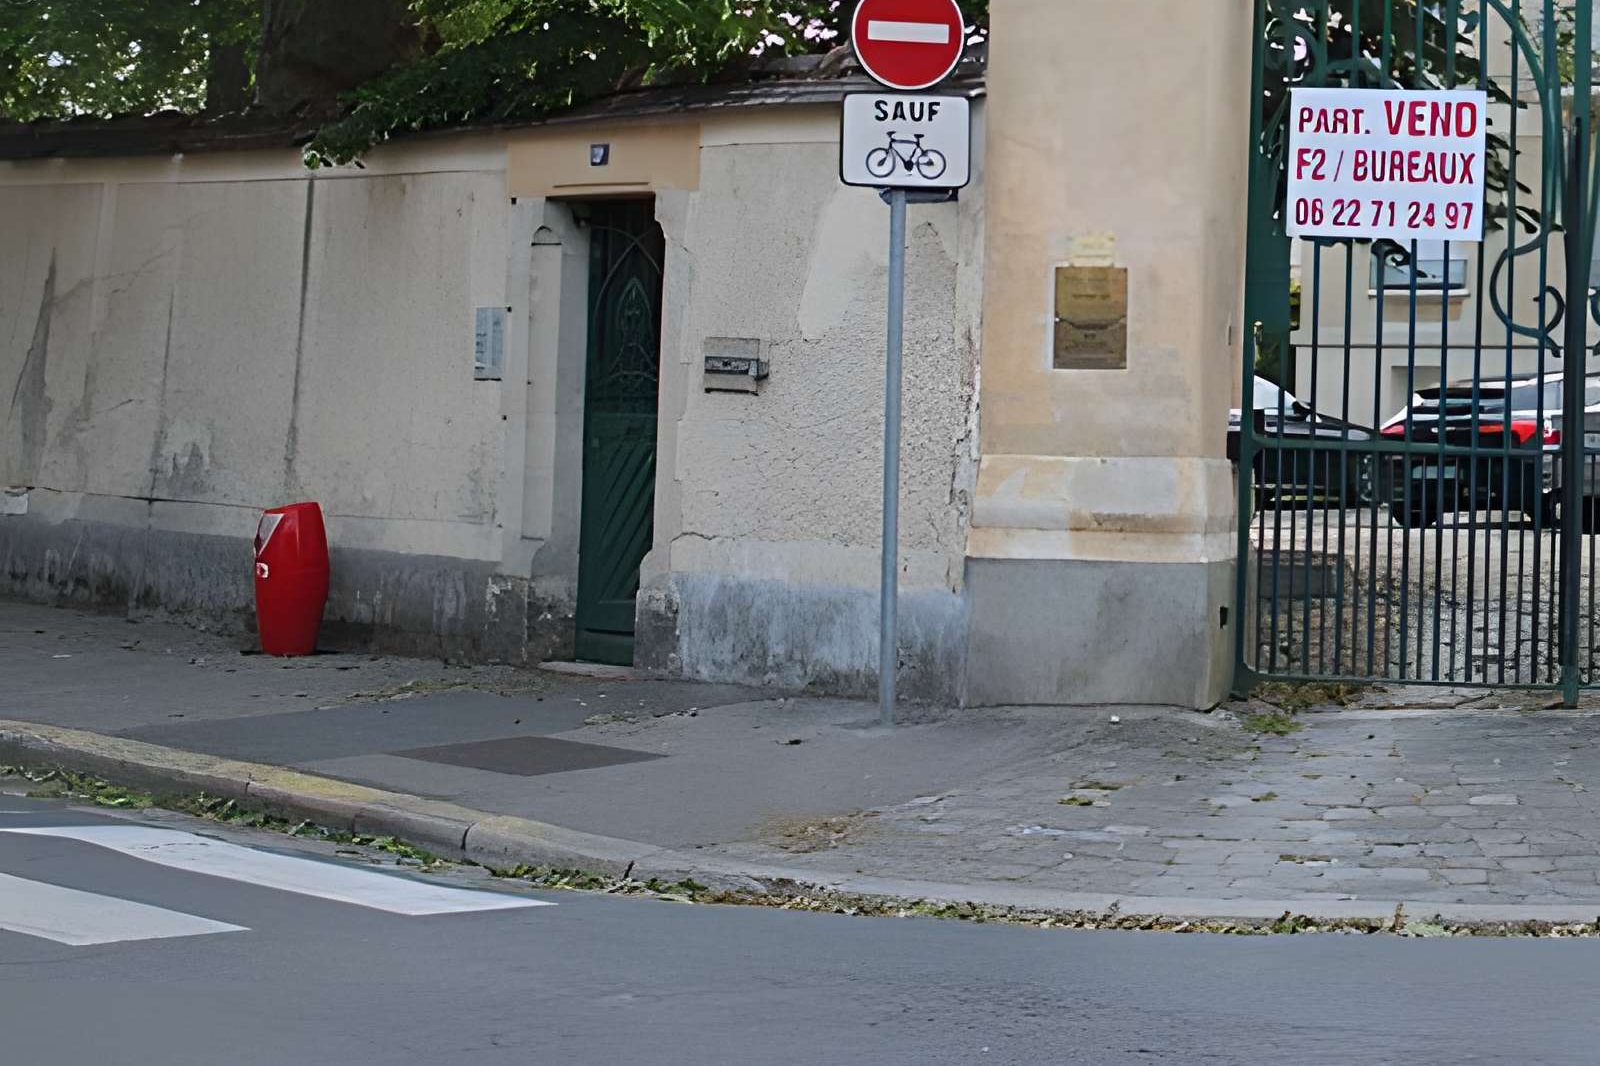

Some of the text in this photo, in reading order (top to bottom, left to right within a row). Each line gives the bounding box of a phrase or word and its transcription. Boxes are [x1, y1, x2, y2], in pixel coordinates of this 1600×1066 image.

[874, 99, 941, 122] SAUF
[1299, 100, 1477, 138] PART. VEND
[1296, 148, 1327, 181] F2
[1352, 149, 1476, 184] BUREAUX
[1295, 197, 1474, 230] 06 22 71 24 97
